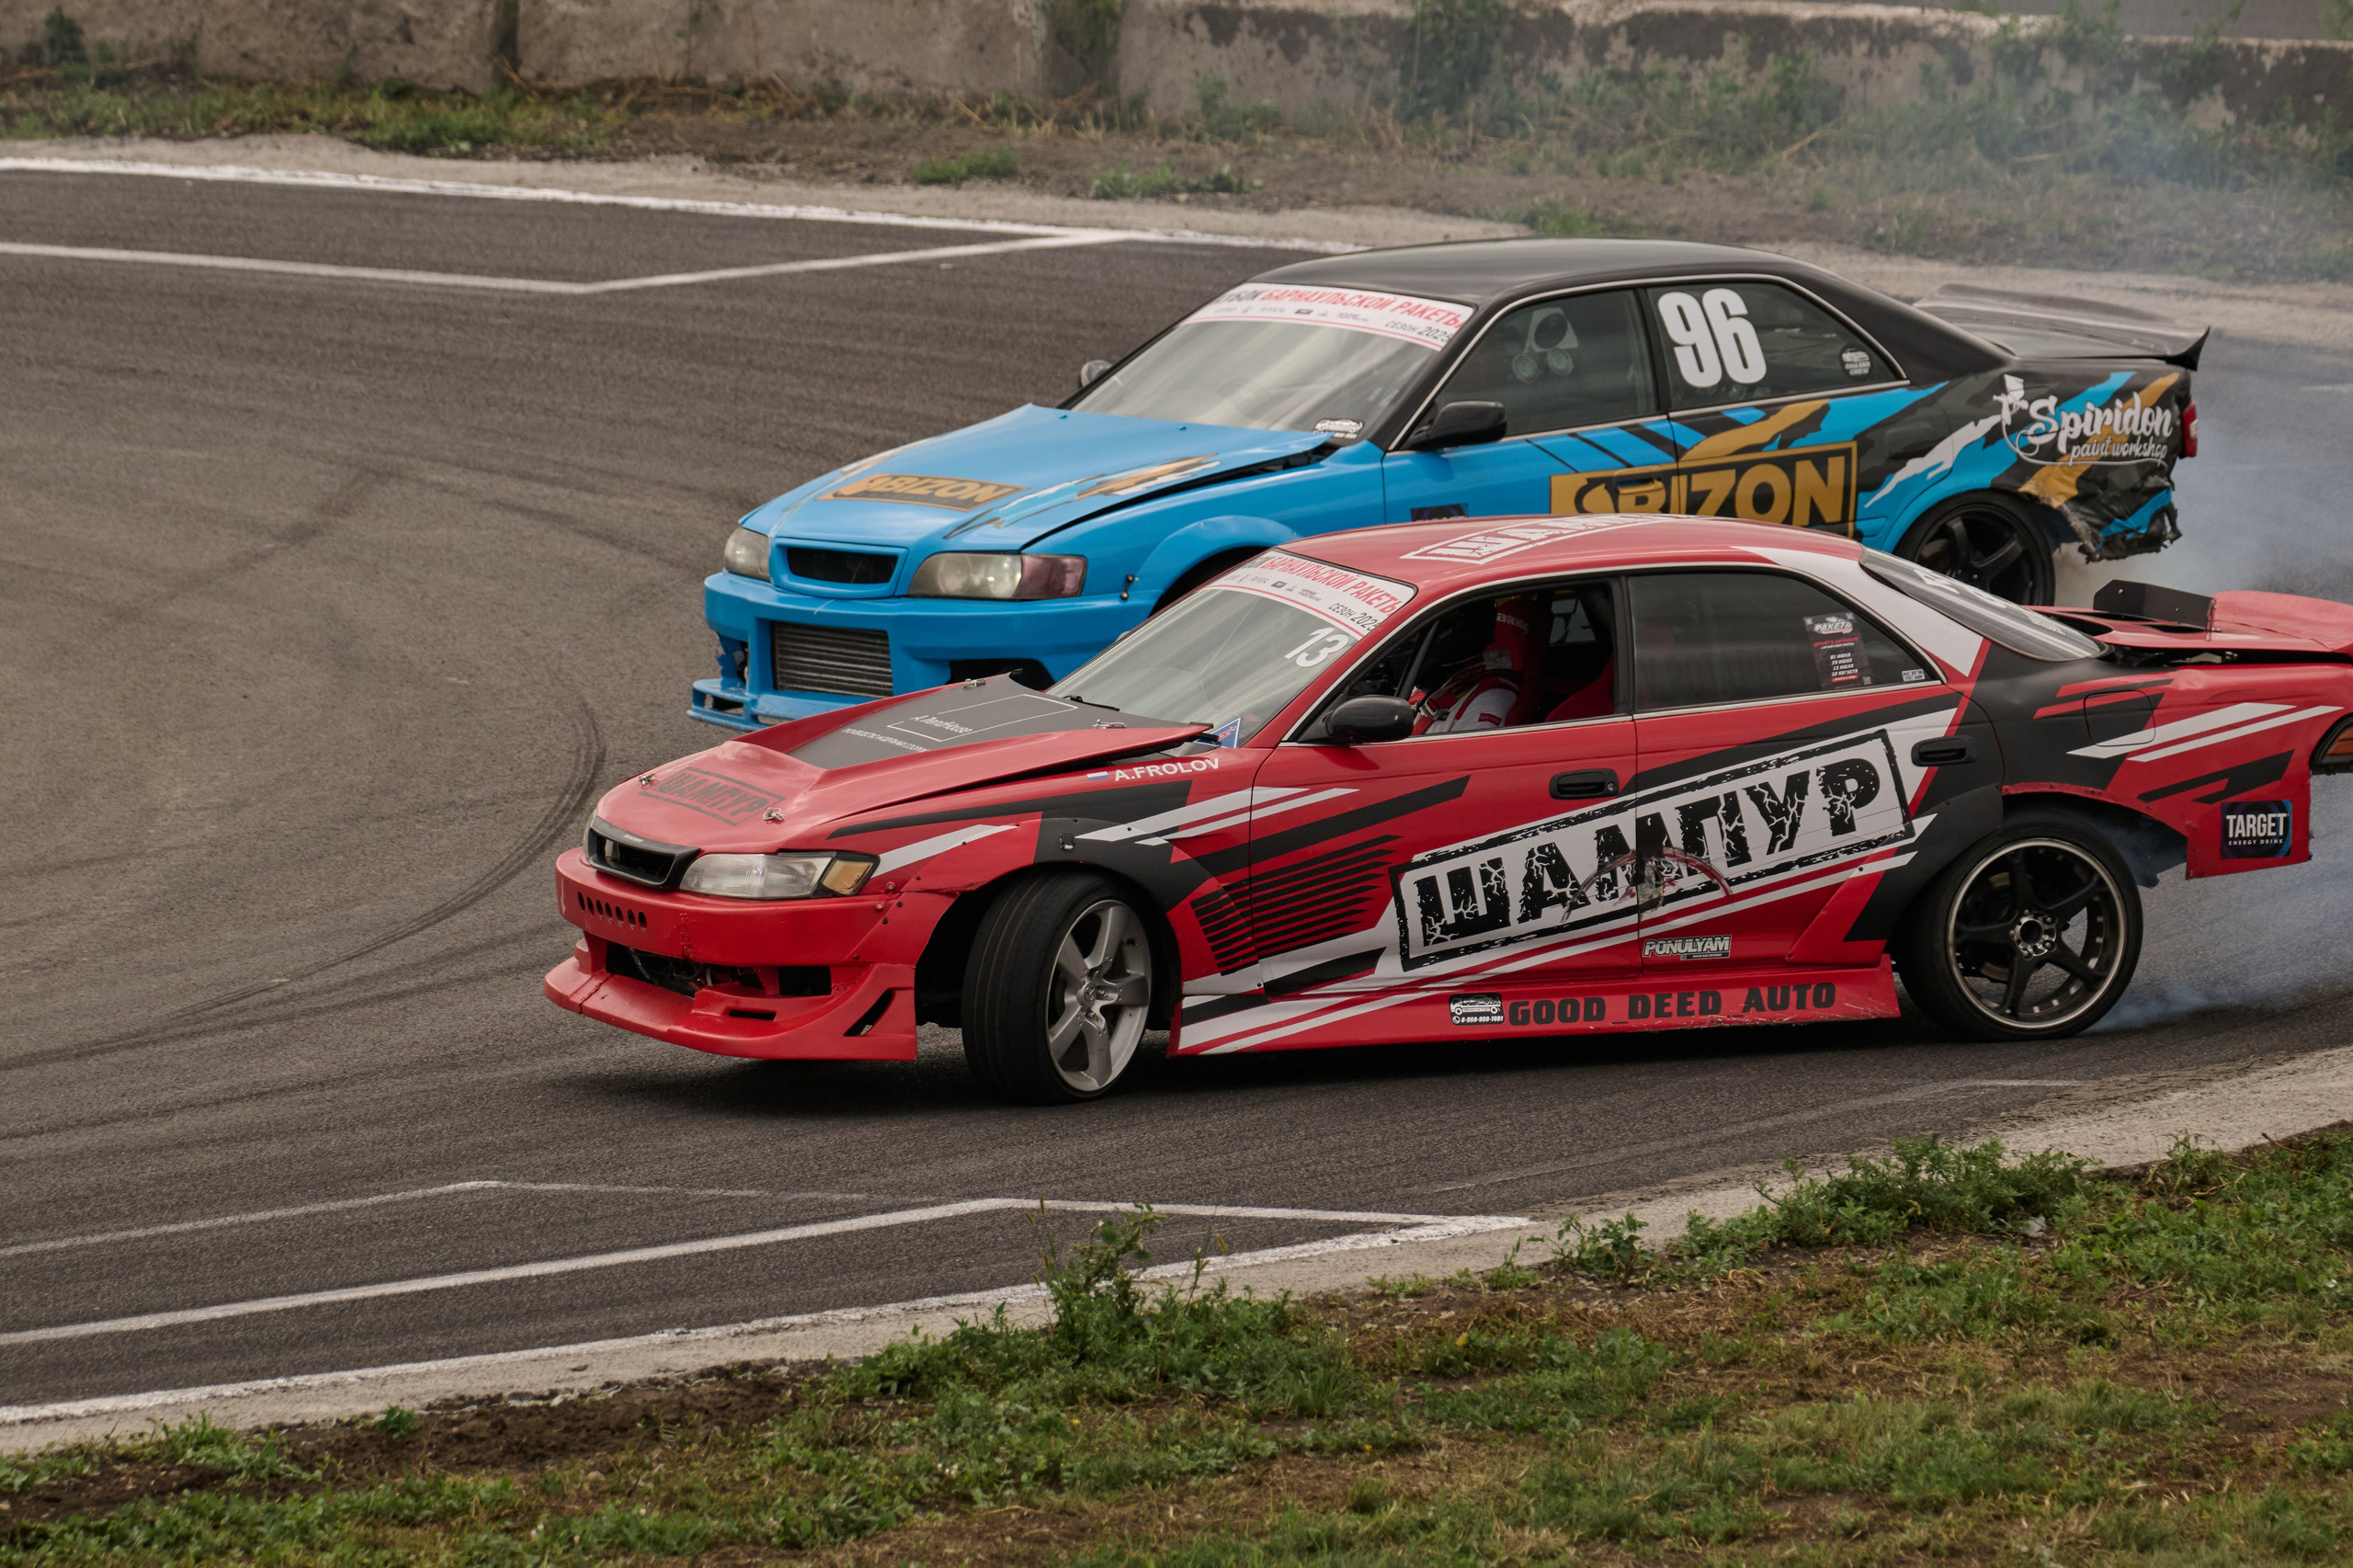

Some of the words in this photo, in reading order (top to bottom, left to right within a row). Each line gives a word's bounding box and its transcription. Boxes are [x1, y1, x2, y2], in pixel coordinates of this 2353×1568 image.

[1260, 289, 1396, 311] БАРНАУЛЬСКОЙ
[1384, 320, 1417, 333] СЕЗОН
[1417, 325, 1453, 343] 2025
[1658, 288, 1767, 387] 96
[2027, 392, 2173, 454] Spiridon
[2070, 436, 2111, 467] paint
[2112, 437, 2168, 466] workshop
[871, 476, 1017, 503] BIZON
[1260, 556, 1361, 590] БАРНАУЛЬСКОЙ
[1328, 603, 1356, 619] СЕЗОН
[1284, 627, 1349, 667] 13
[1115, 758, 1220, 781] A.FROLOV
[652, 772, 770, 816] ШАМПУР
[2226, 813, 2287, 838] TARGET
[1415, 757, 1881, 947] ШАМПУР
[1643, 935, 1731, 956] PONULYAM
